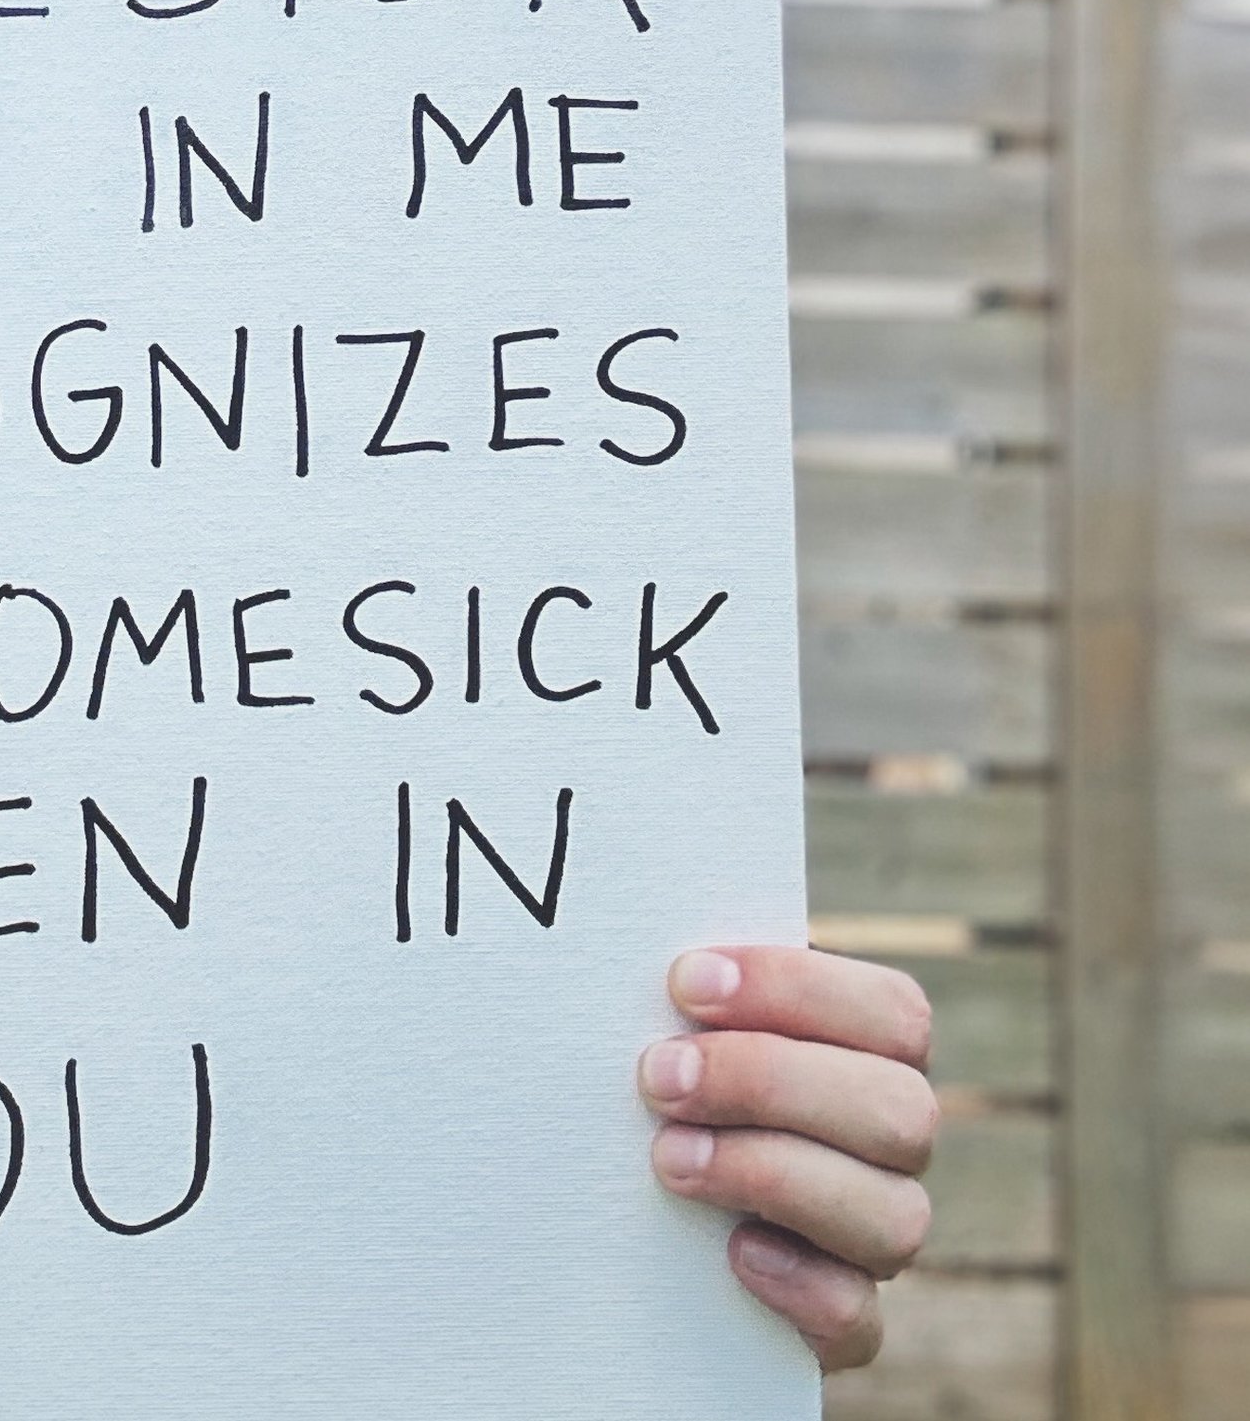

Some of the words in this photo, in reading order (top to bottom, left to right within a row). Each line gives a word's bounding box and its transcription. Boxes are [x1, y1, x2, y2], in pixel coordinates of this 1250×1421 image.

[139, 91, 270, 233] IN
[406, 87, 638, 219] ME
[396, 781, 573, 943] IN
